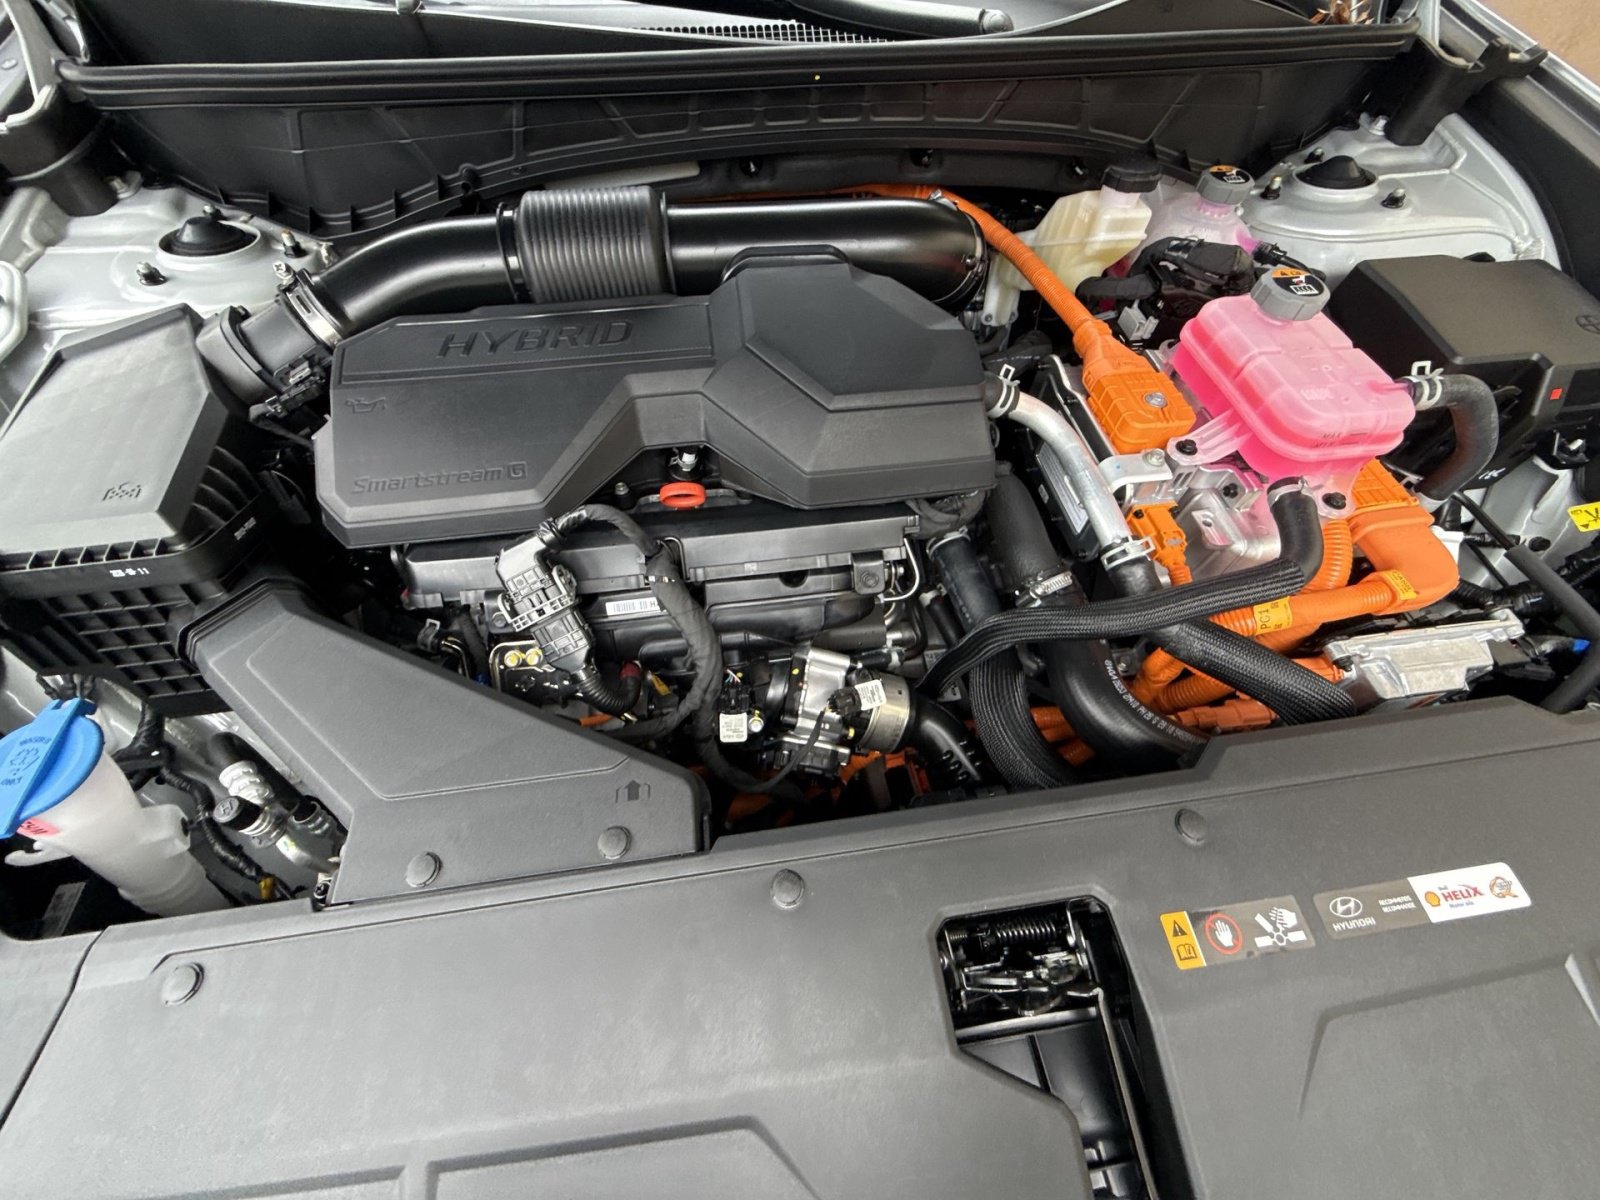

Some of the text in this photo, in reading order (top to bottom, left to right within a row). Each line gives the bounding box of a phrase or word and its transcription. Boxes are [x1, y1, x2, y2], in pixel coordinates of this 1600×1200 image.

[436, 320, 634, 359] HYBRID
[351, 465, 505, 495] Smartstream
[1441, 886, 1484, 902] HELIX
[1332, 916, 1376, 932] HYUNDAI
